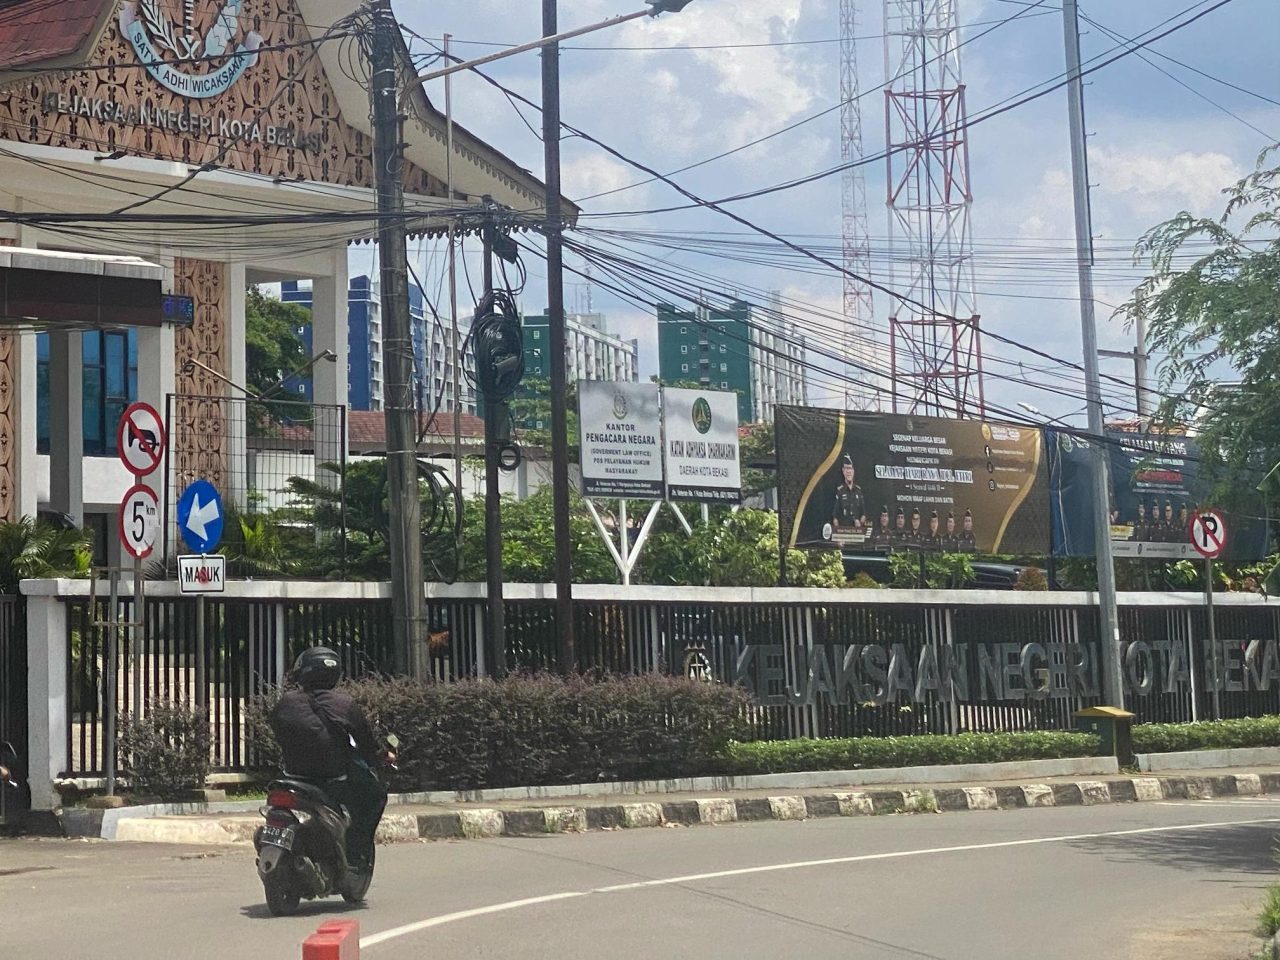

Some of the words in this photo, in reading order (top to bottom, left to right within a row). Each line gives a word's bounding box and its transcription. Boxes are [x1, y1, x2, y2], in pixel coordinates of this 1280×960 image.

[163, 71, 189, 91] ADHI
[191, 56, 245, 93] WICAKSANA
[156, 110, 215, 135] NEGERI
[220, 117, 261, 141] KOTA
[606, 423, 635, 432] KANTOR
[586, 433, 627, 445] PENGACARA
[628, 434, 656, 445] NEGARA
[604, 467, 638, 475] MASYARAKAT
[679, 465, 699, 476] DAERAH
[700, 466, 712, 476] KOTA
[712, 467, 729, 478] BEKASI
[131, 501, 145, 542] 5
[146, 505, 156, 515] km
[185, 566, 220, 583] MASUK
[728, 643, 969, 705] KEJAKSAAN
[977, 641, 1101, 700] NEGERI
[1119, 640, 1193, 695] OTA
